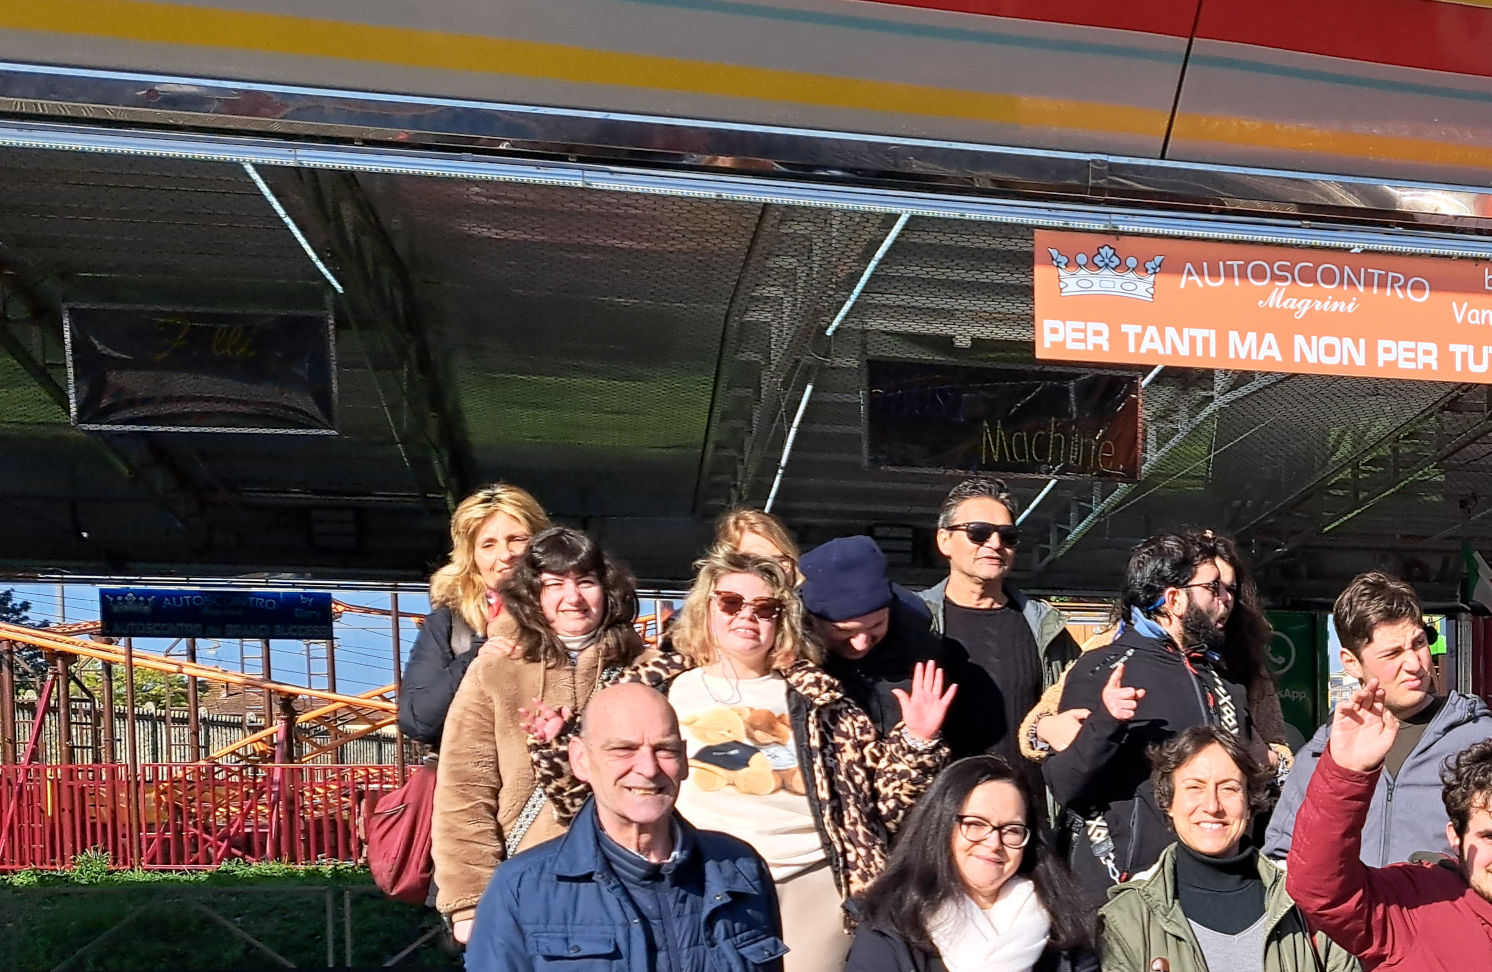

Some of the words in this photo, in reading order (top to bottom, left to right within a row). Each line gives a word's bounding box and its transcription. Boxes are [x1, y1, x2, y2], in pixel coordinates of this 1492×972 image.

[1180, 260, 1431, 303] AUTOSCONTRO
[1258, 288, 1360, 319] Magrini
[1043, 319, 1110, 351] PER
[1121, 324, 1217, 358] TANTI
[1228, 330, 1282, 362] MA
[1293, 334, 1366, 366] NON
[1377, 339, 1438, 371] PER
